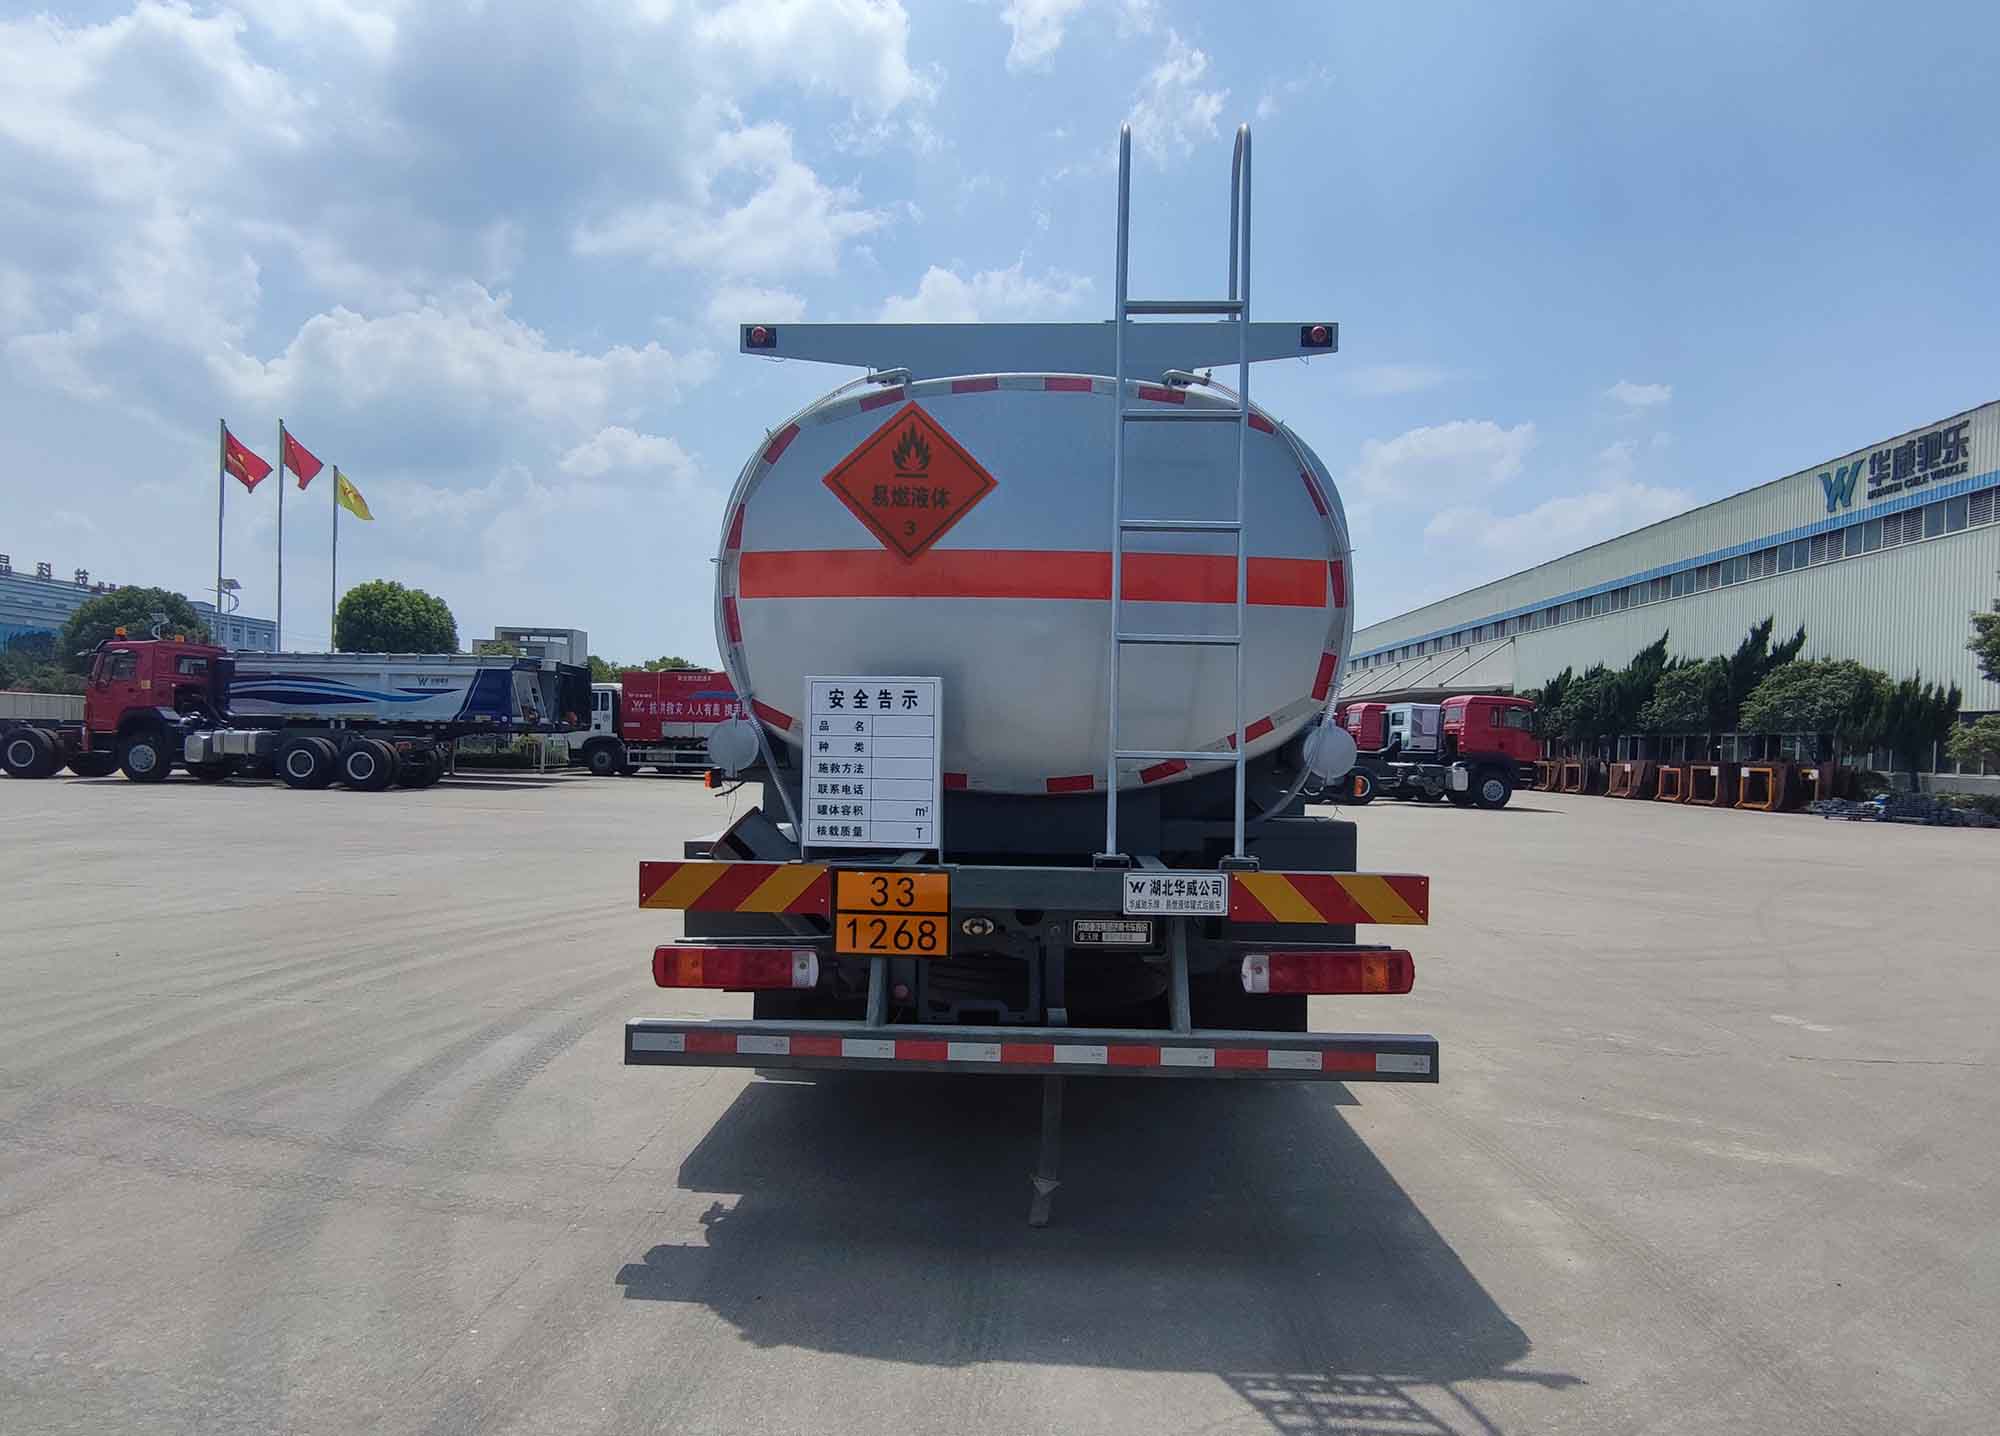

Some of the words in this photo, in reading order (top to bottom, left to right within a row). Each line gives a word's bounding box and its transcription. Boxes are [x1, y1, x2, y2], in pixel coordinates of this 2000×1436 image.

[1868, 419, 1970, 487] 华威驰乐
[872, 485, 950, 509] 易燃液体
[904, 520, 917, 537] 3
[829, 688, 918, 710] 安全告示
[818, 763, 864, 774] 施救方法
[818, 784, 864, 795] 联系电话
[817, 805, 864, 816] 罐体容积
[817, 826, 863, 837] 核载质量
[915, 827, 923, 839] T
[870, 877, 915, 907] 33
[1149, 879, 1222, 896] 湖北华威公司
[846, 919, 937, 951] 1268
